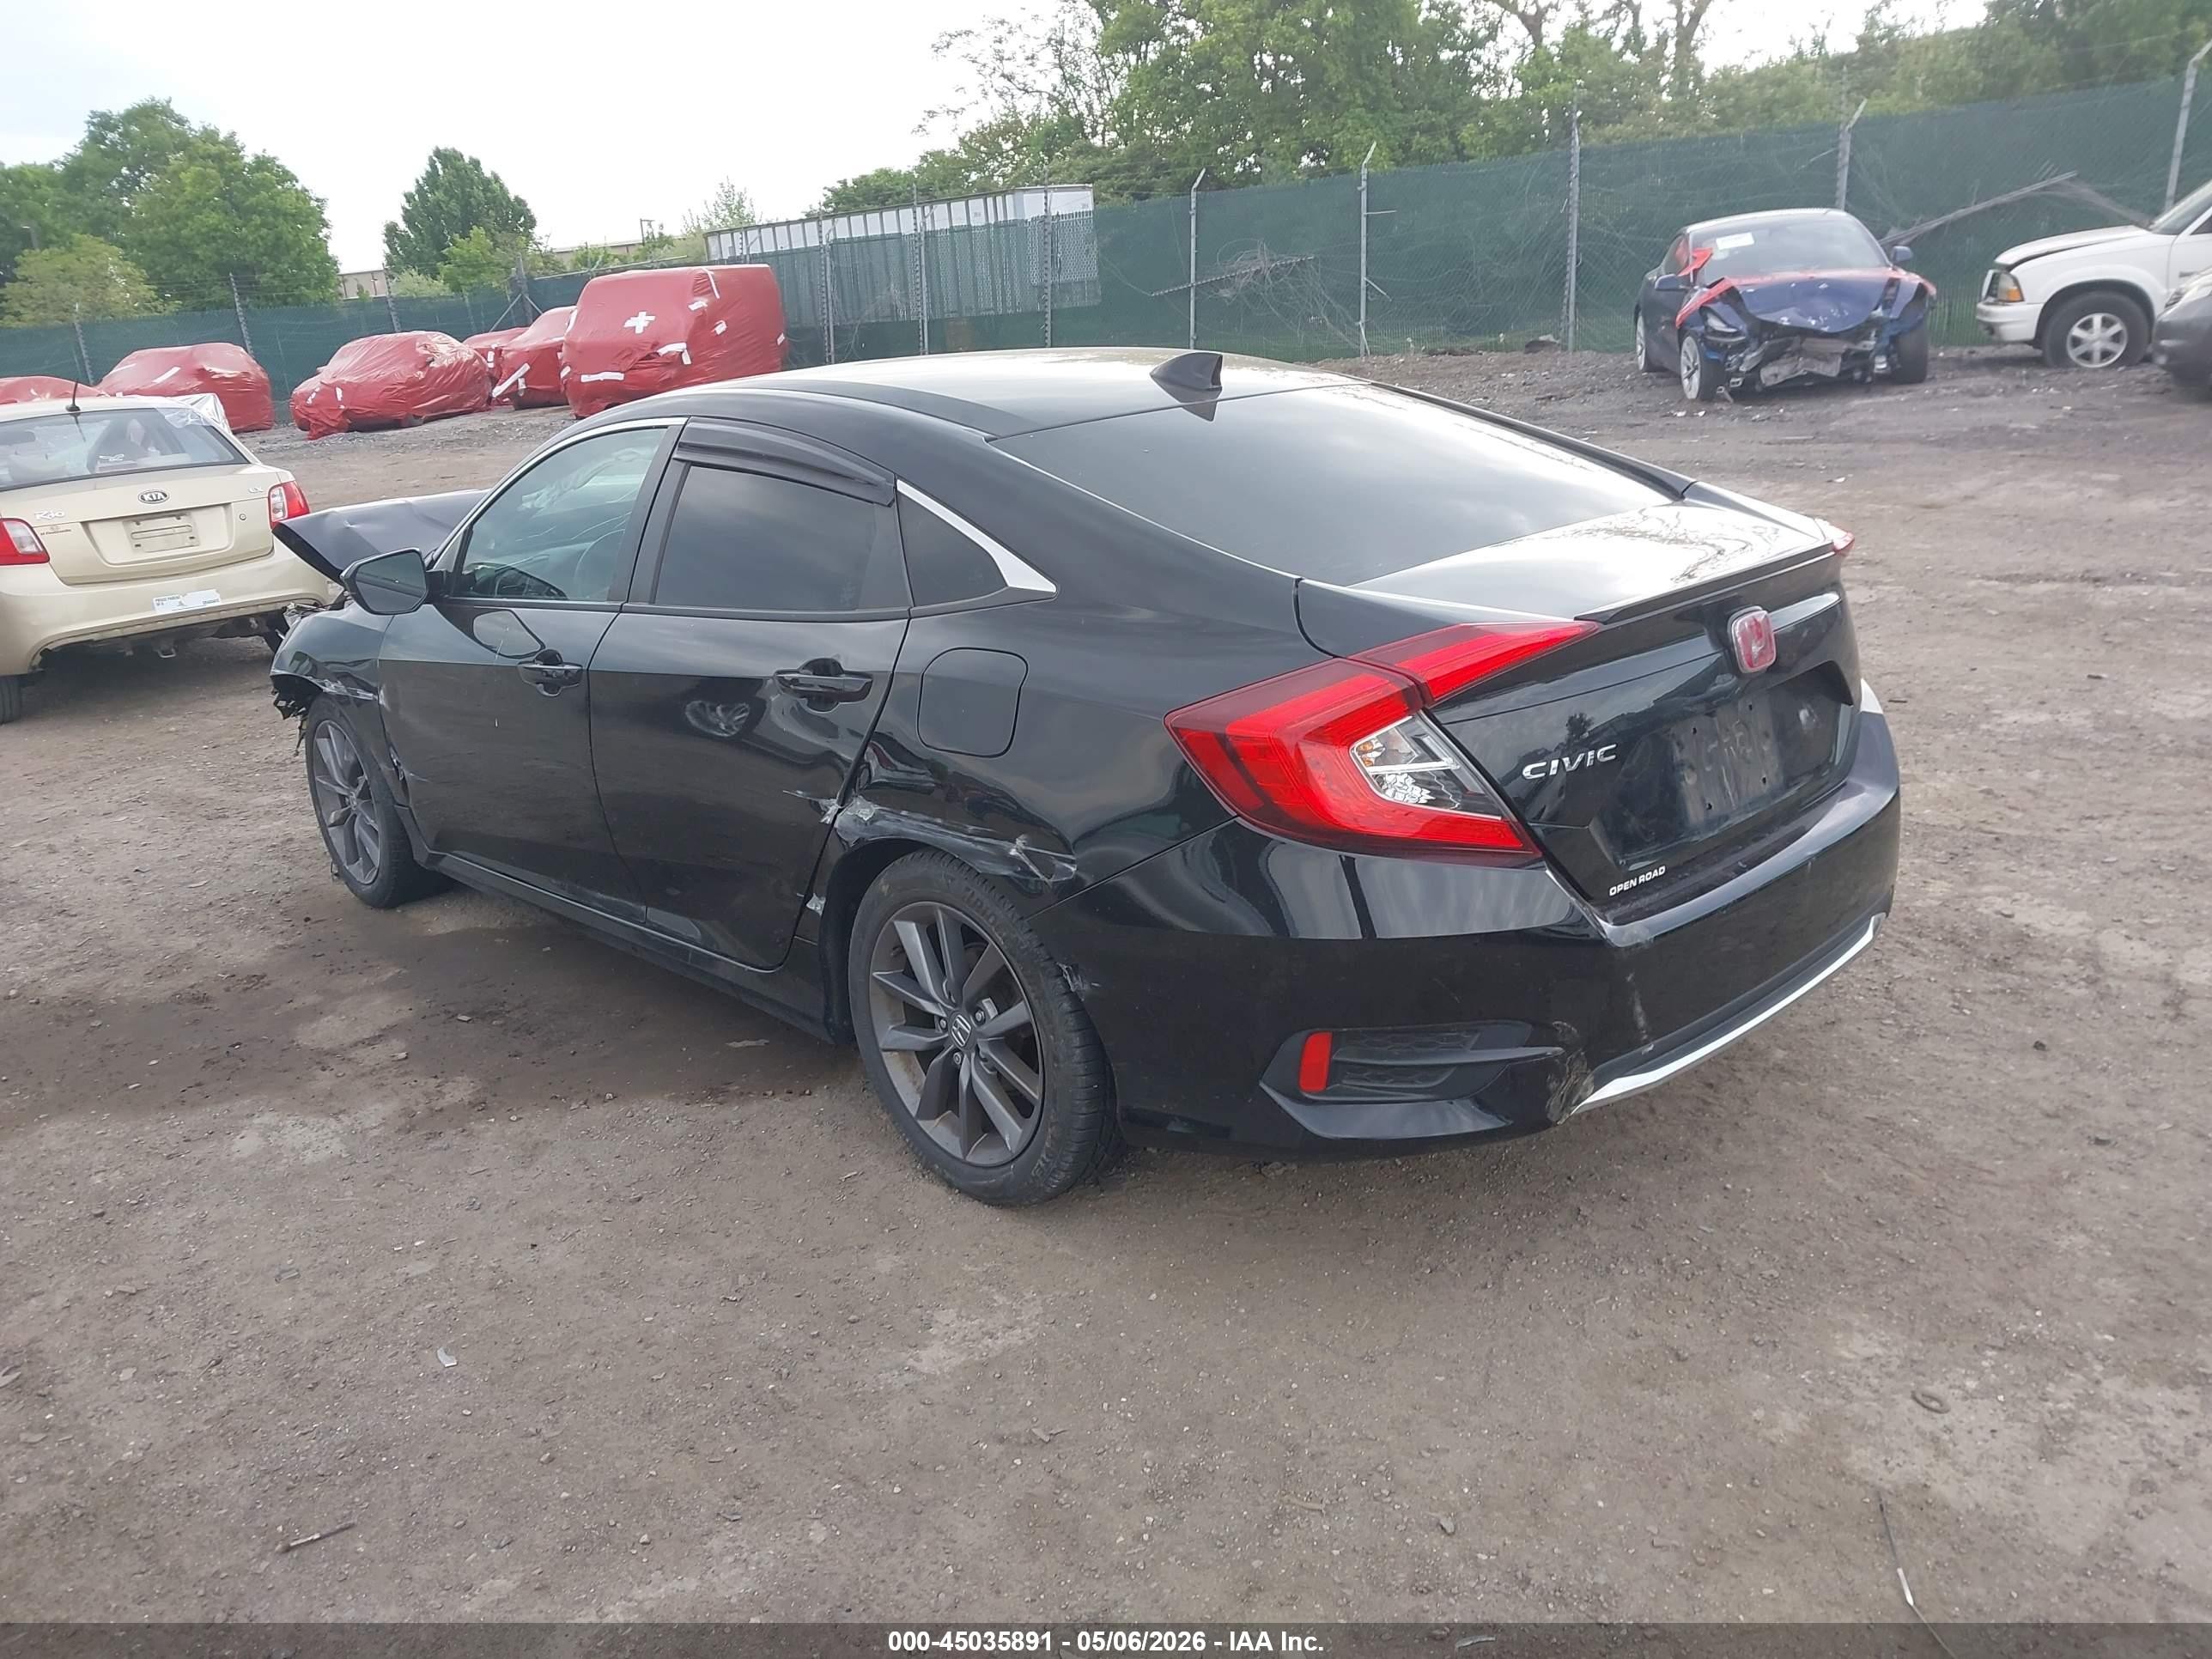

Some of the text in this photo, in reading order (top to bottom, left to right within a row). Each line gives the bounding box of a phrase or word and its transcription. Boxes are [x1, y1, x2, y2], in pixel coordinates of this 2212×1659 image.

[142, 490, 167, 502] KIA
[1522, 743, 1617, 780] CIVIC
[1608, 865, 1666, 896] OPEN ROAD
